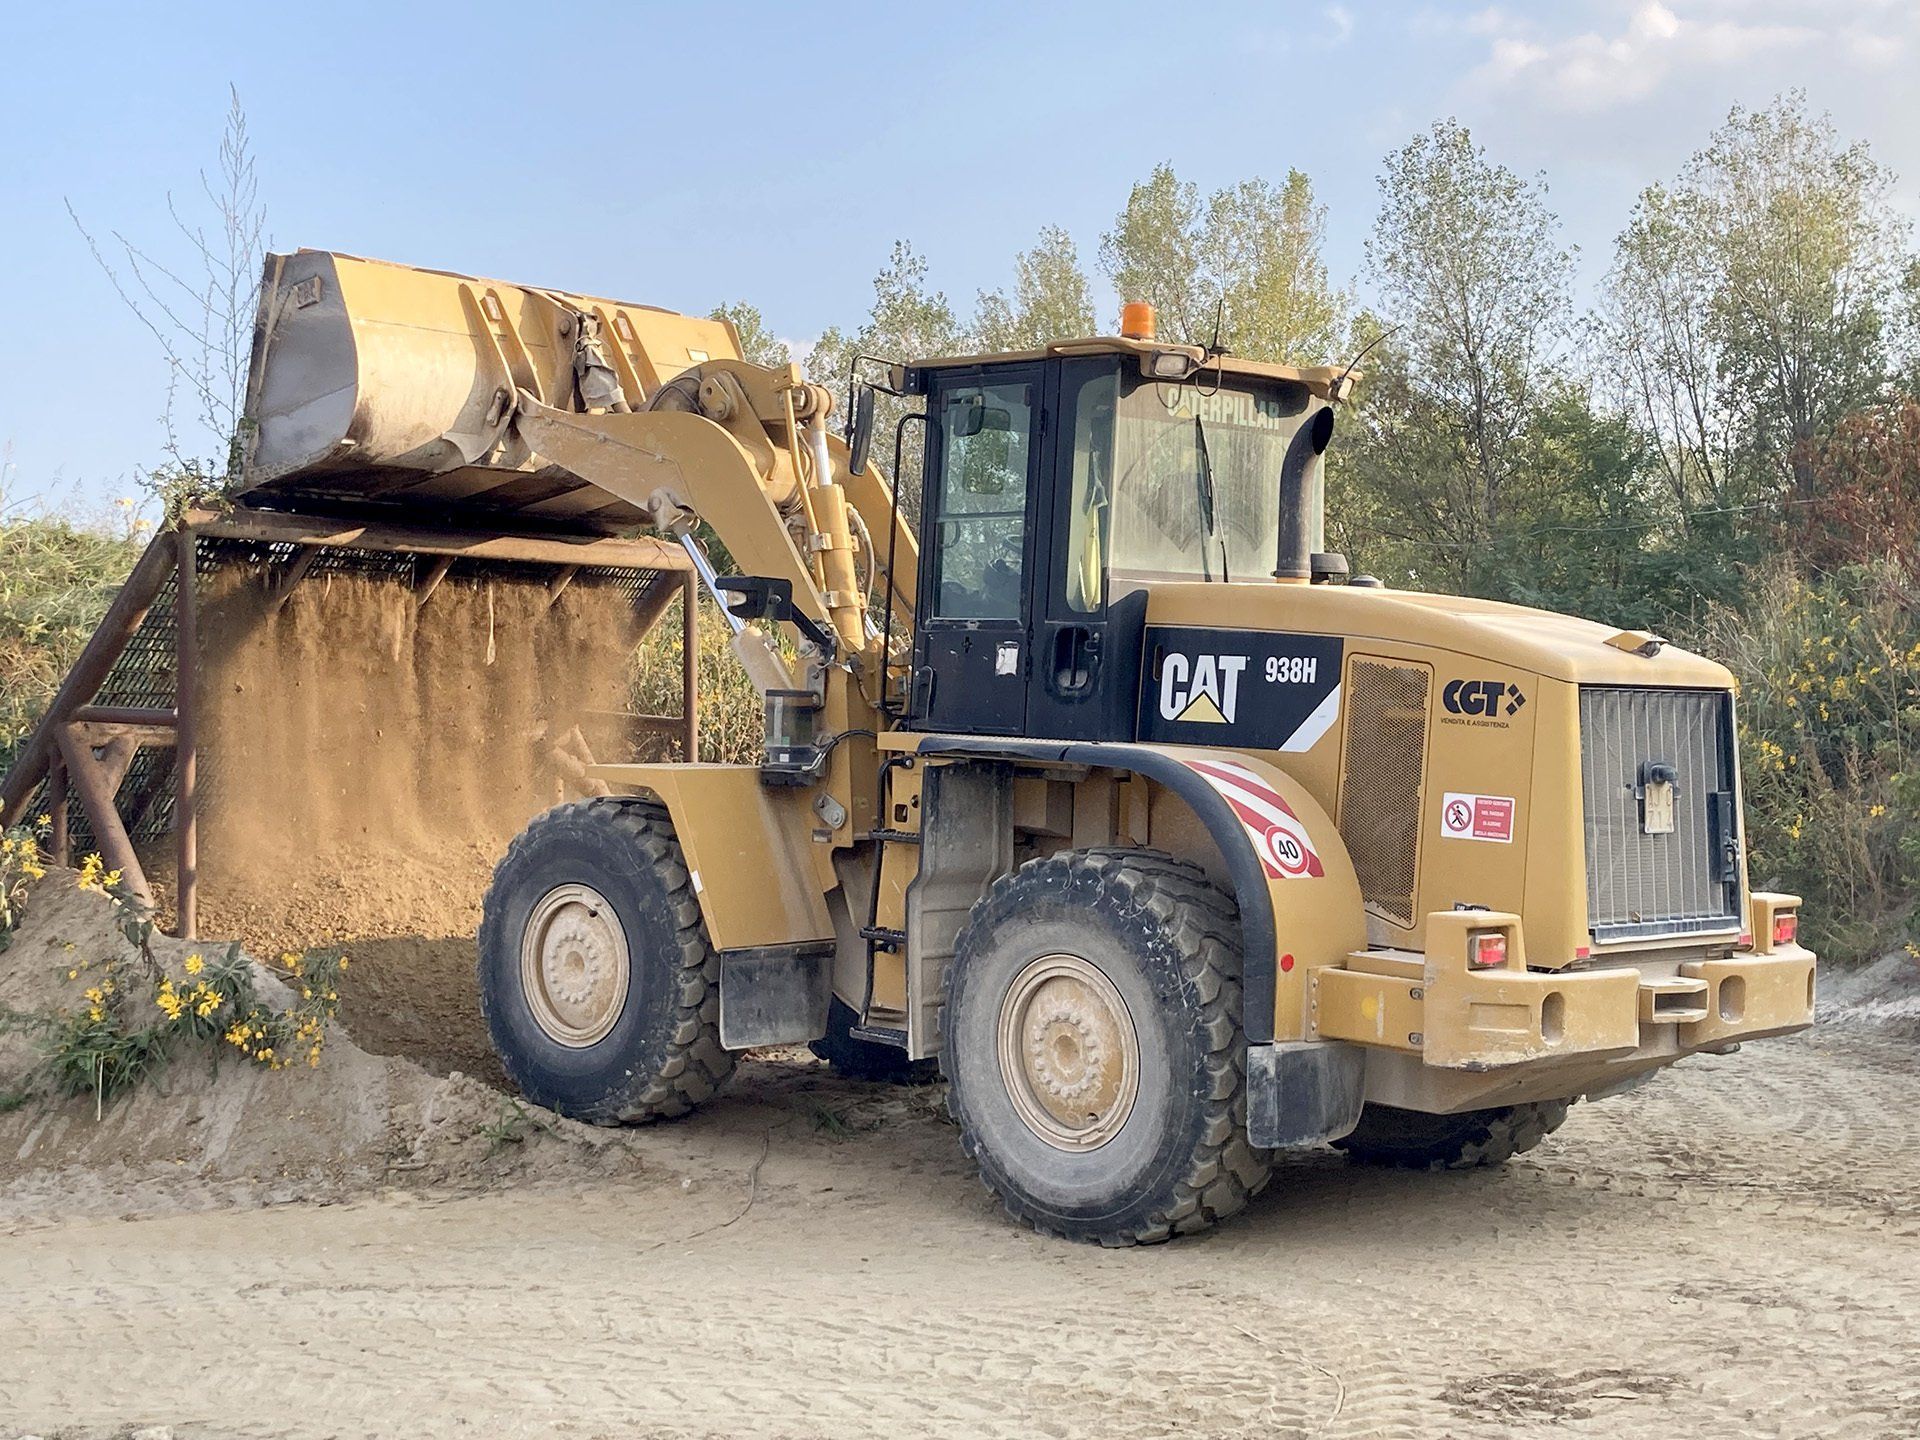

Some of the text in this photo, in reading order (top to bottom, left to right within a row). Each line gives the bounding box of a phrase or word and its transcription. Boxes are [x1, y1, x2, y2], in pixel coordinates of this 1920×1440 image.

[1167, 387, 1280, 430] CATERPILLAR
[1159, 652, 1317, 724] CAT 938H
[1443, 679, 1505, 717] CGT
[1278, 839, 1299, 860] 40
